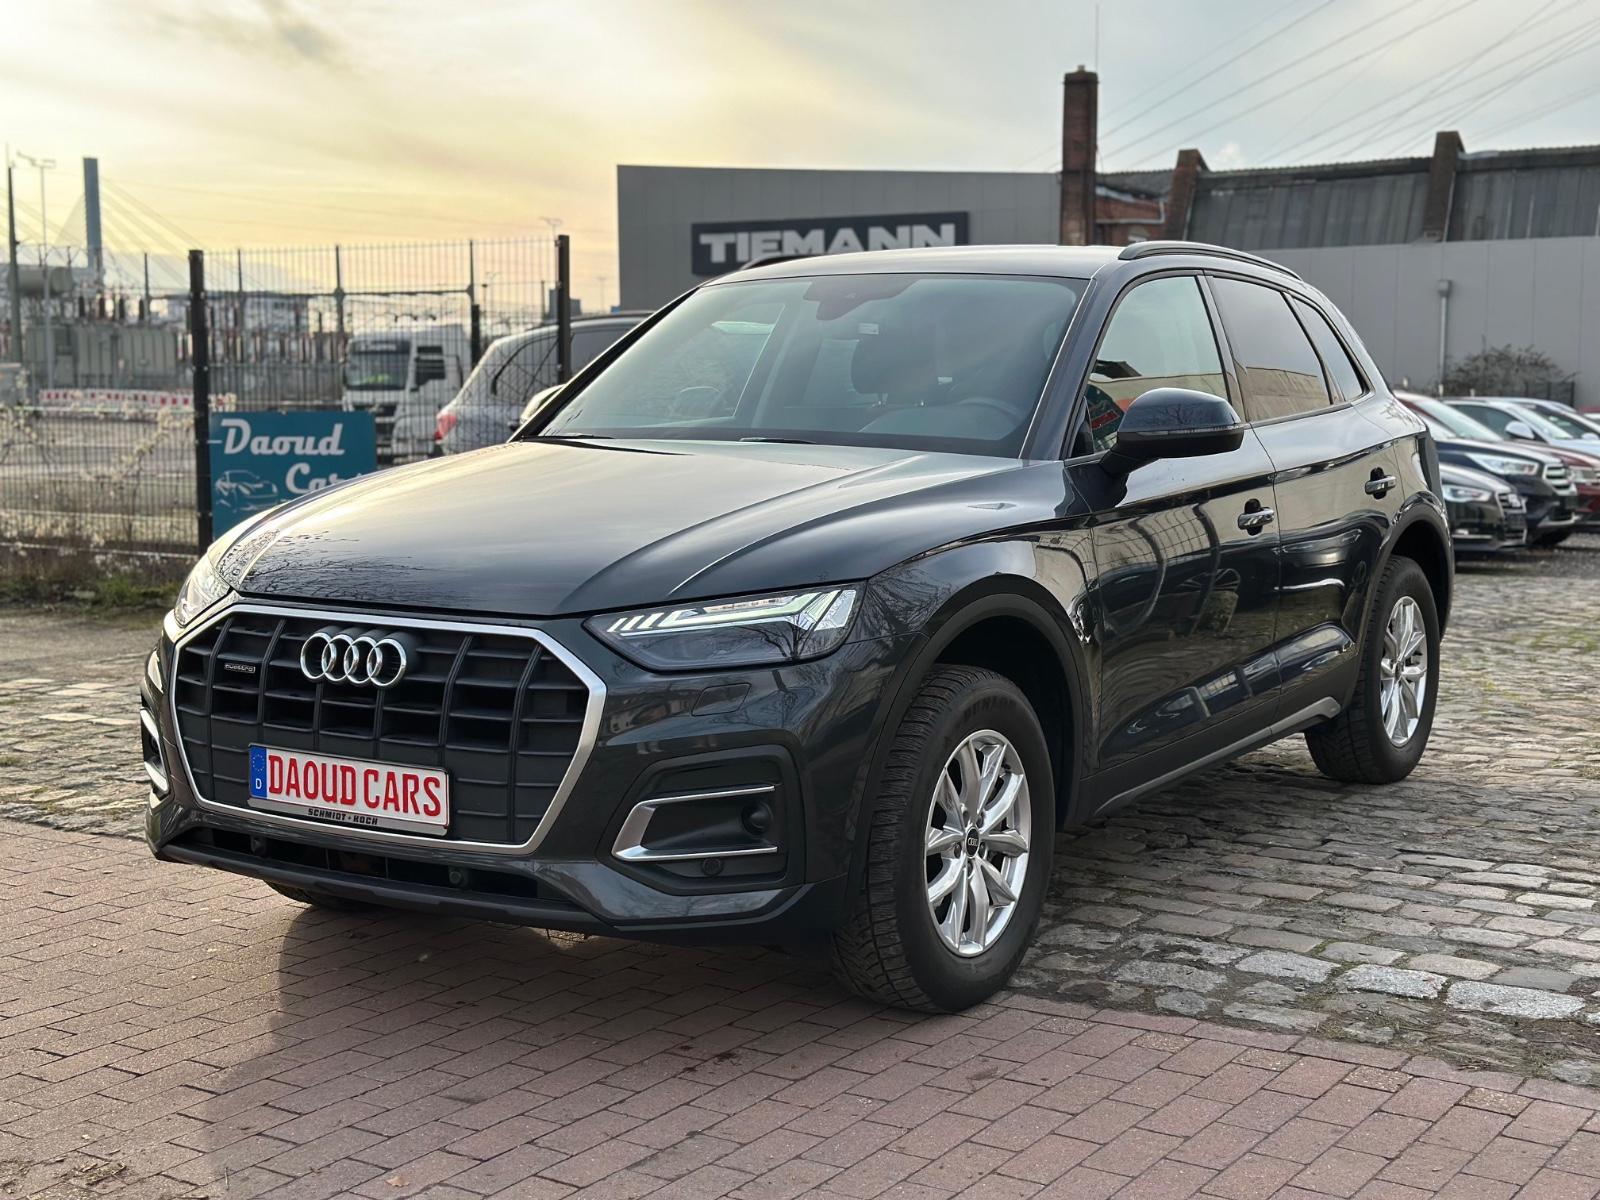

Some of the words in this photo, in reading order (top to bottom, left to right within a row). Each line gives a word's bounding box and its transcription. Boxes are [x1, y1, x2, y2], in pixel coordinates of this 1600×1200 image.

[699, 223, 955, 263] TIEMANN
[220, 418, 345, 455] Daoud
[285, 462, 363, 494] Car
[255, 778, 262, 790] D
[268, 754, 356, 806] DAOUD
[363, 768, 441, 817] CARS
[308, 807, 346, 821] SCHMIDT
[353, 816, 378, 826] KOCH
